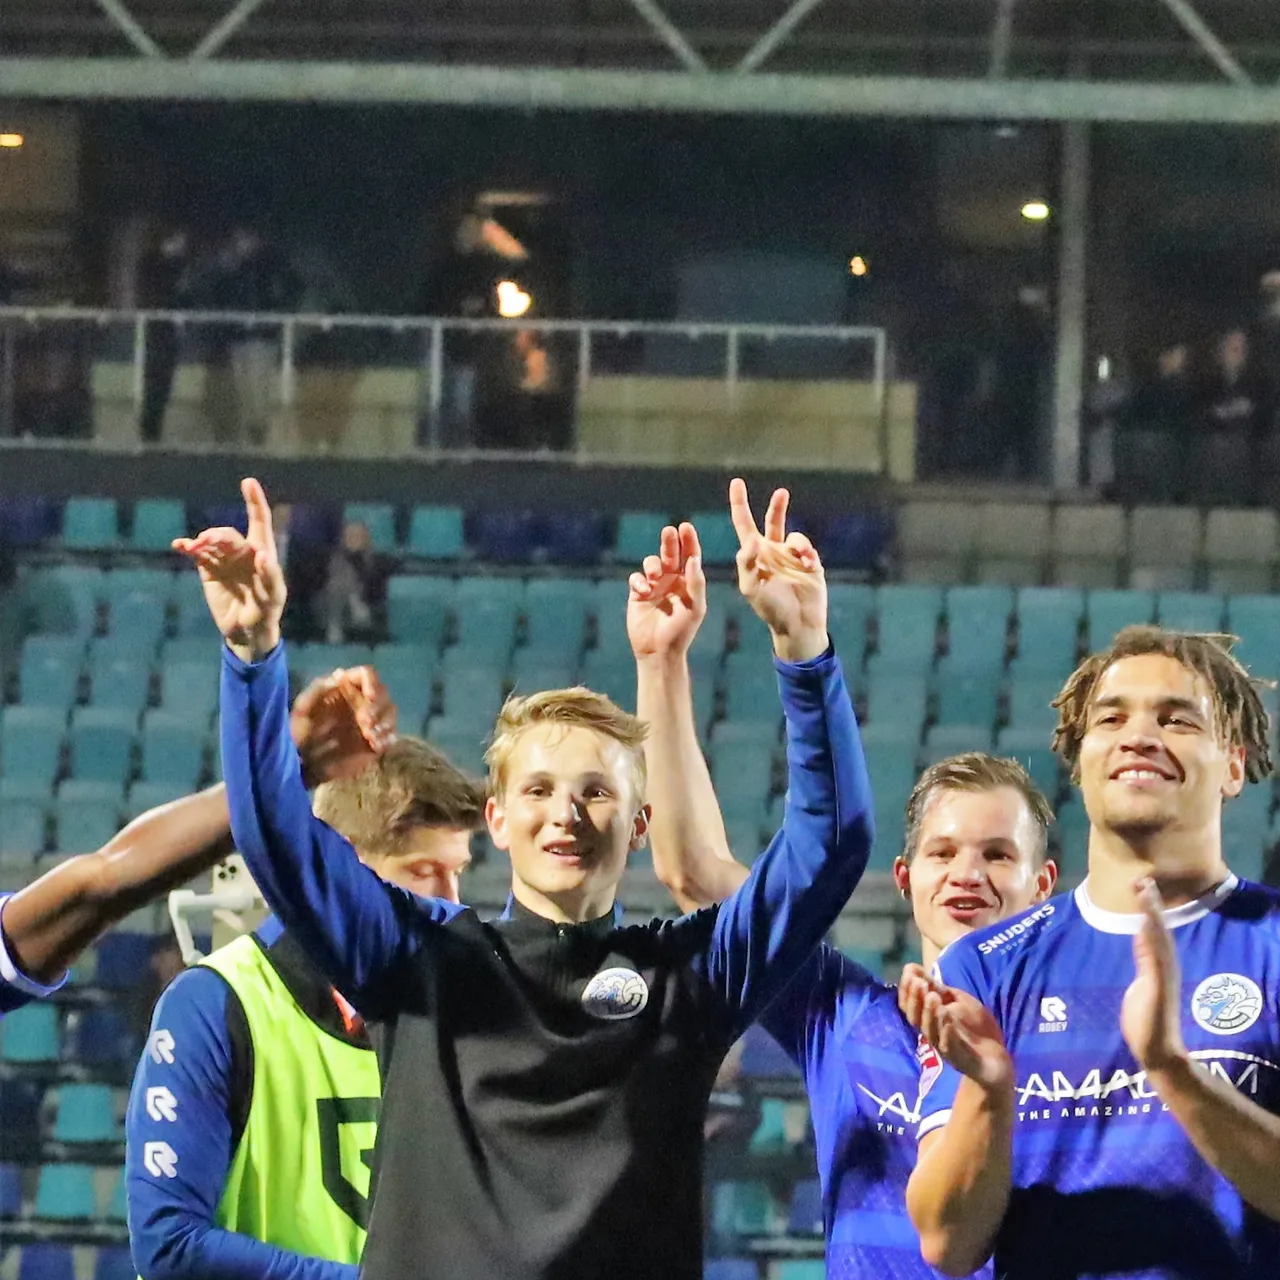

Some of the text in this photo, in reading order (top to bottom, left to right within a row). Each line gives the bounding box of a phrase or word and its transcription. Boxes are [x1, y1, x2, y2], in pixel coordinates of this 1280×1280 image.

[977, 903, 1056, 955] SNIJDERS
[1013, 1061, 1260, 1106] AMACM
[1018, 1109, 1051, 1122] THE
[1060, 1102, 1152, 1118] AMAZING
[876, 1122, 906, 1136] THE
